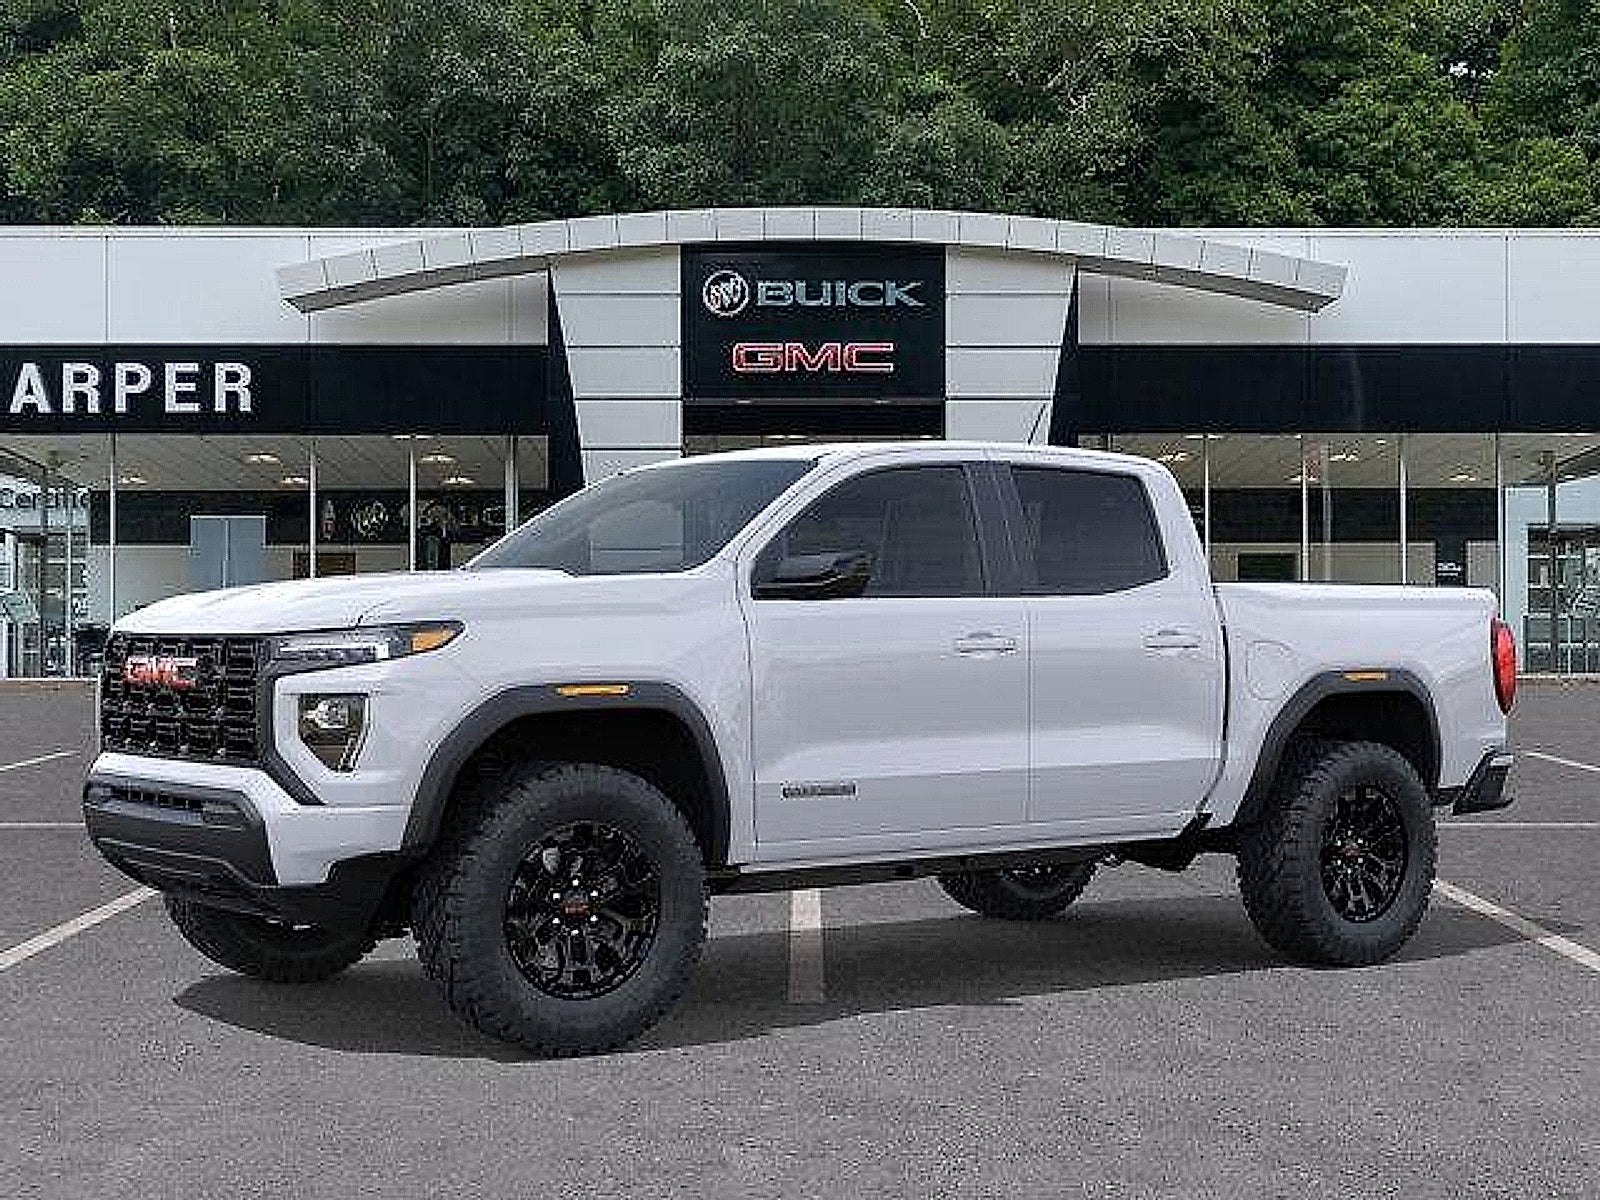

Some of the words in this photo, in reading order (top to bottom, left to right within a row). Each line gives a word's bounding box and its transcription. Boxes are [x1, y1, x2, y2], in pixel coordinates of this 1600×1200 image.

[757, 281, 925, 306] BUICK
[732, 342, 895, 372] GMC
[9, 362, 252, 413] ARPER
